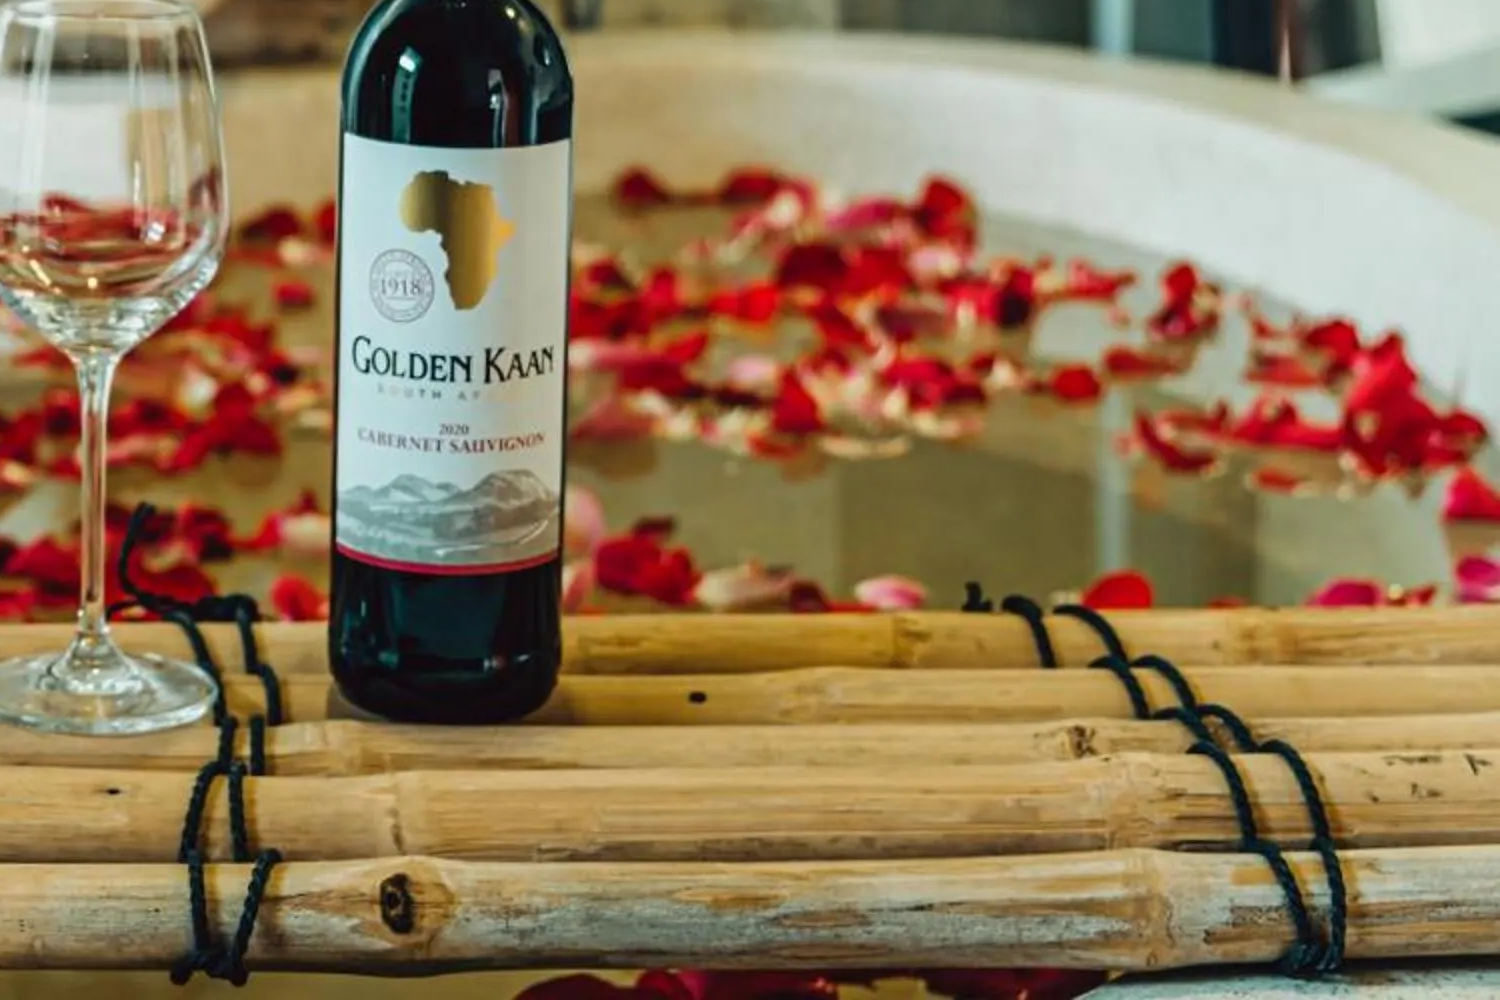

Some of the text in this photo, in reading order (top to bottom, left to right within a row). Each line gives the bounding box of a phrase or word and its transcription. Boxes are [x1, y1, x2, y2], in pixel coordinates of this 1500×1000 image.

[380, 278, 422, 297] 1918
[351, 335, 555, 384] GOLDEN KAAN
[357, 427, 546, 454] CABERNET SAUVIGNON
[438, 423, 470, 436] 2020
